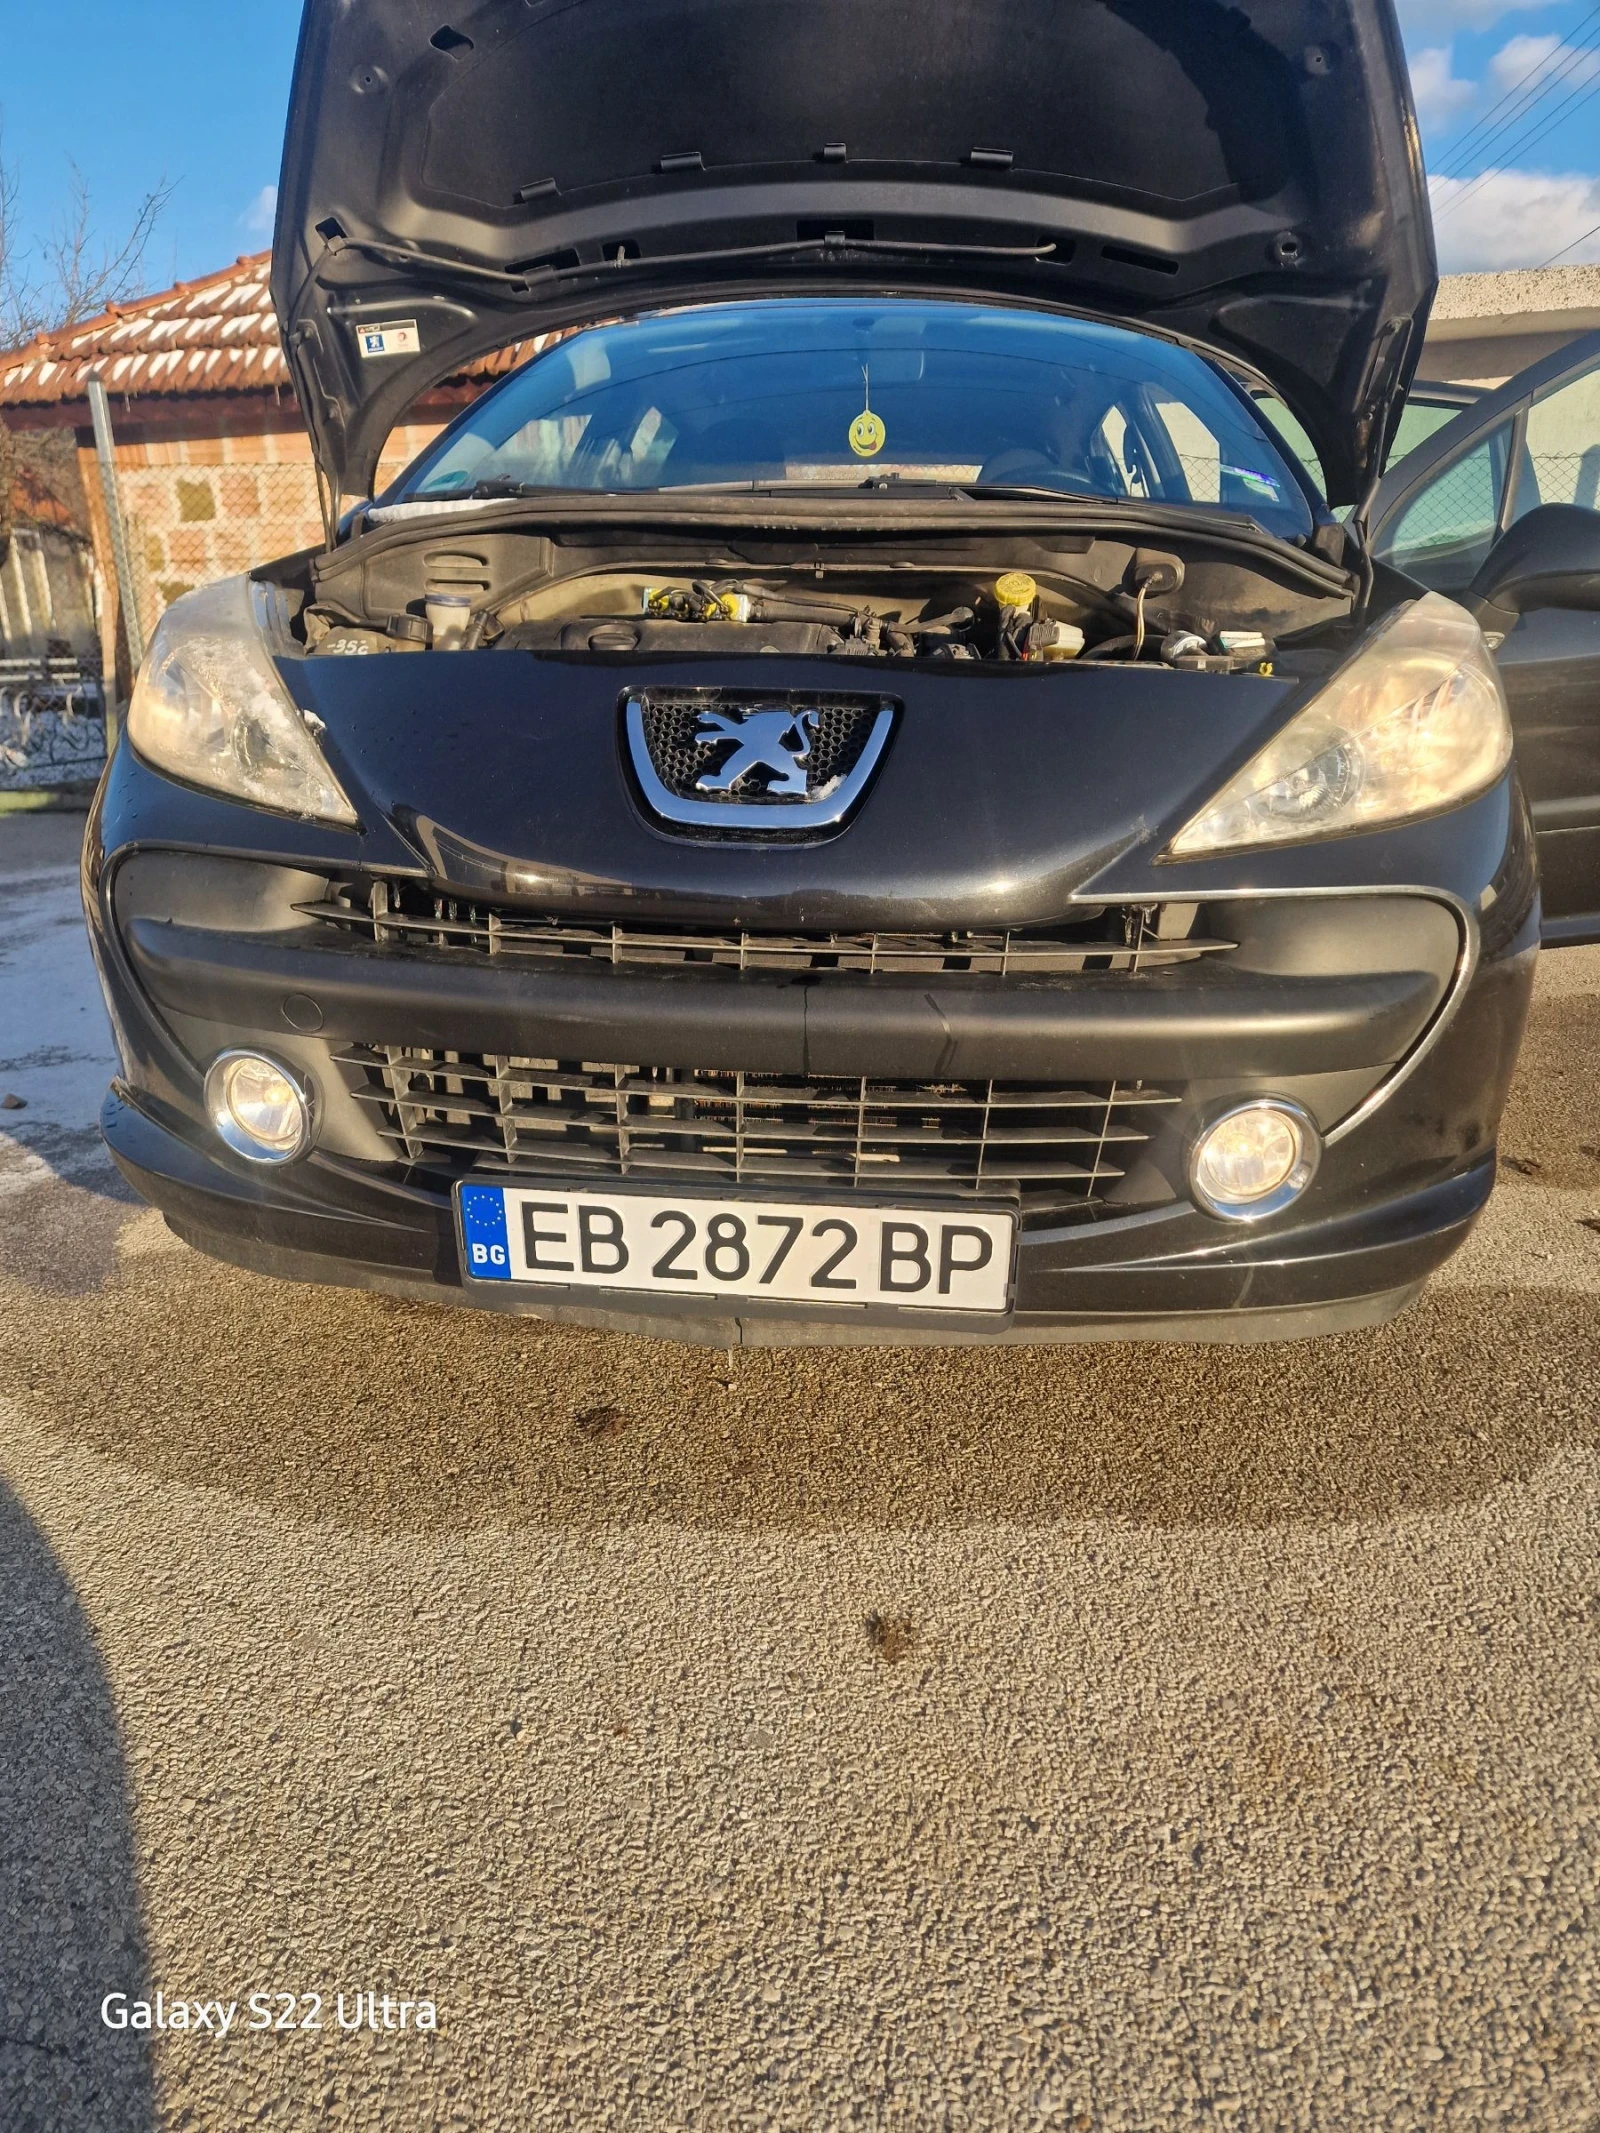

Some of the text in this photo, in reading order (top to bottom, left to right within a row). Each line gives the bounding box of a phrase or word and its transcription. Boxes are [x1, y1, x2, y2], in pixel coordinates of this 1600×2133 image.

[472, 1243, 505, 1265] BG
[521, 1201, 993, 1295] EB 2872 BP
